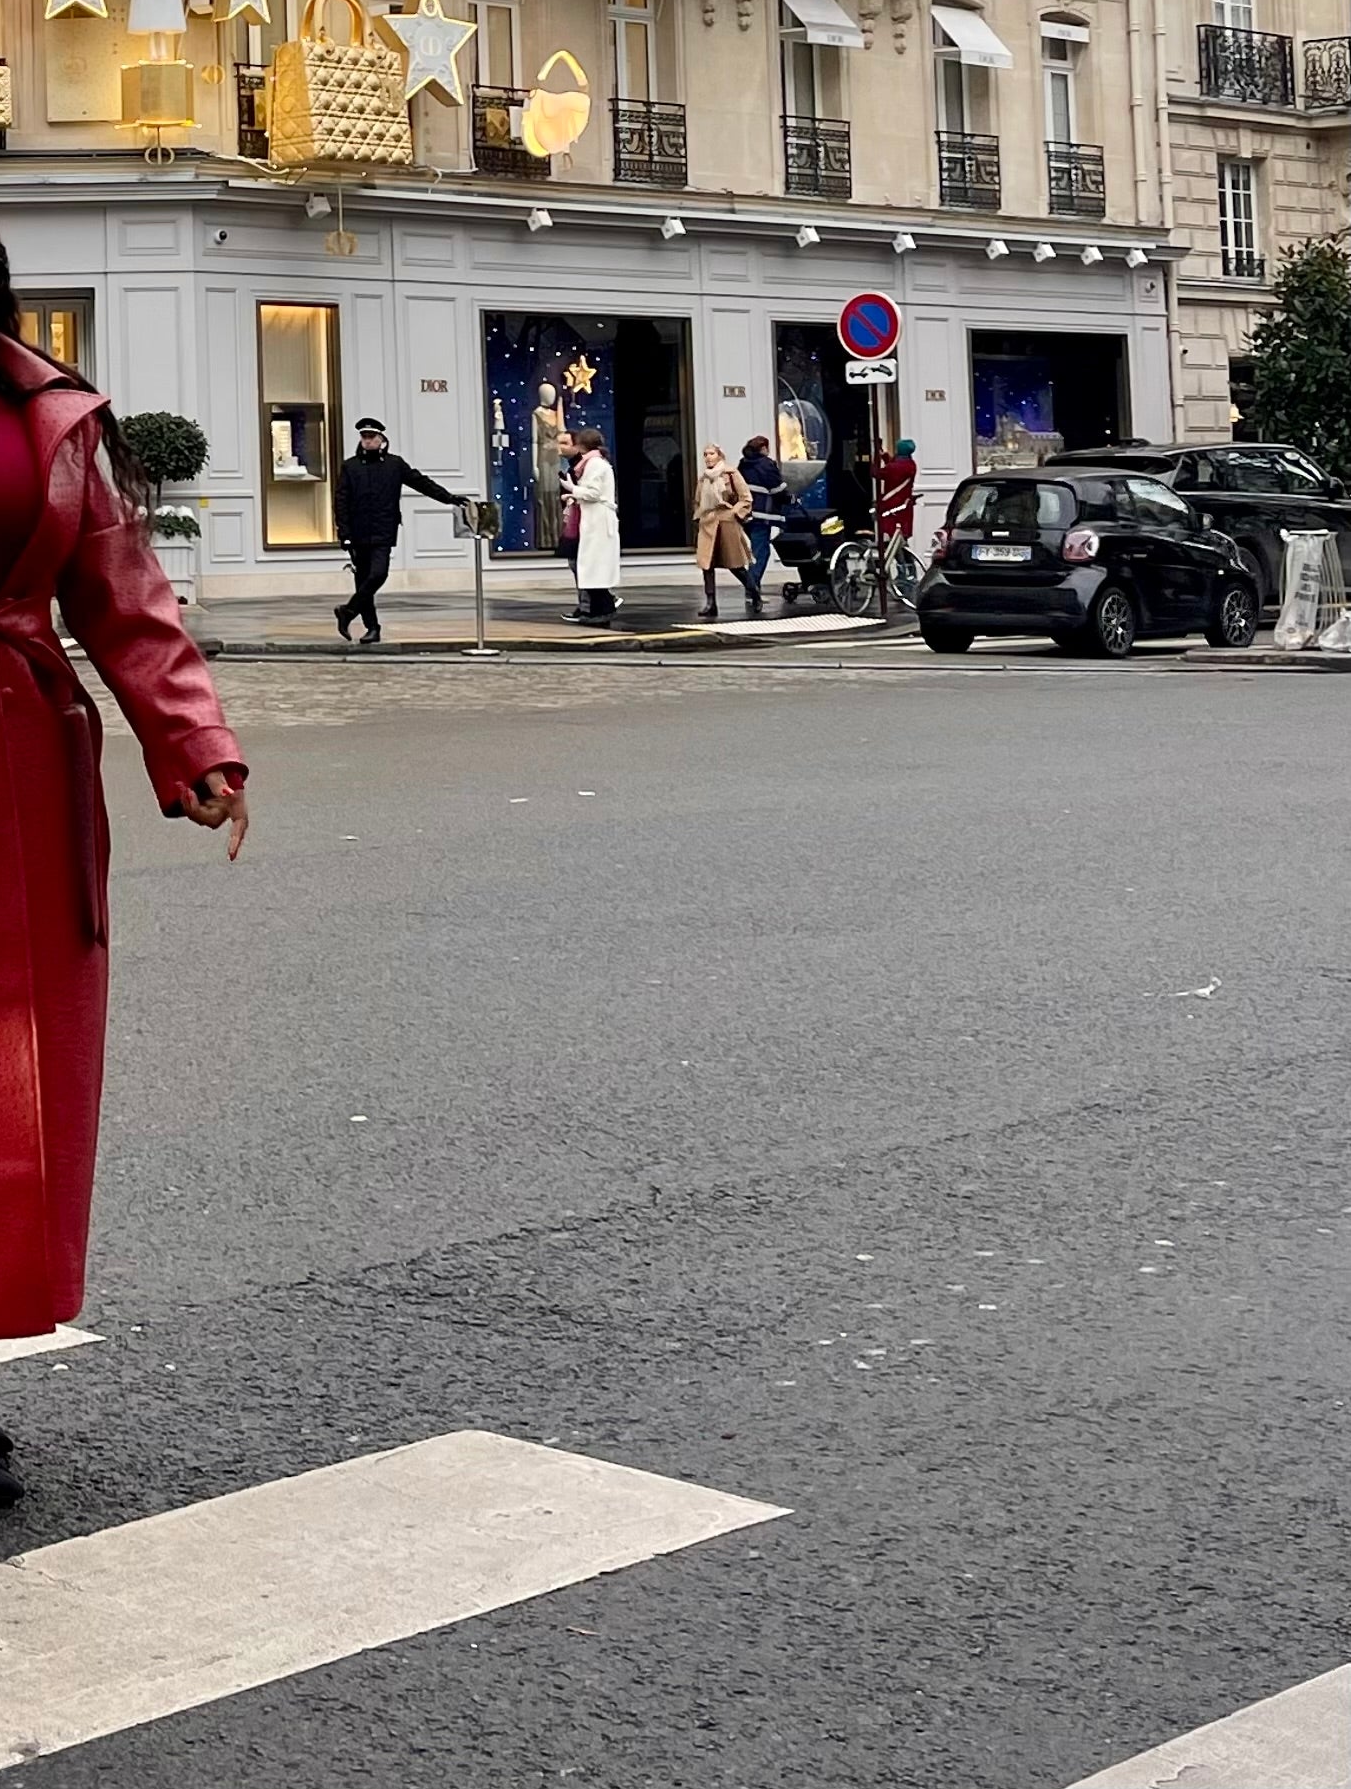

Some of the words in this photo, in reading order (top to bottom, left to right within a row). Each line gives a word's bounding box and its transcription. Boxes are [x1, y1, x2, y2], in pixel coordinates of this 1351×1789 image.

[421, 379, 449, 393] DIOR
[723, 385, 746, 398] DIOR
[925, 389, 946, 402] DIOR
